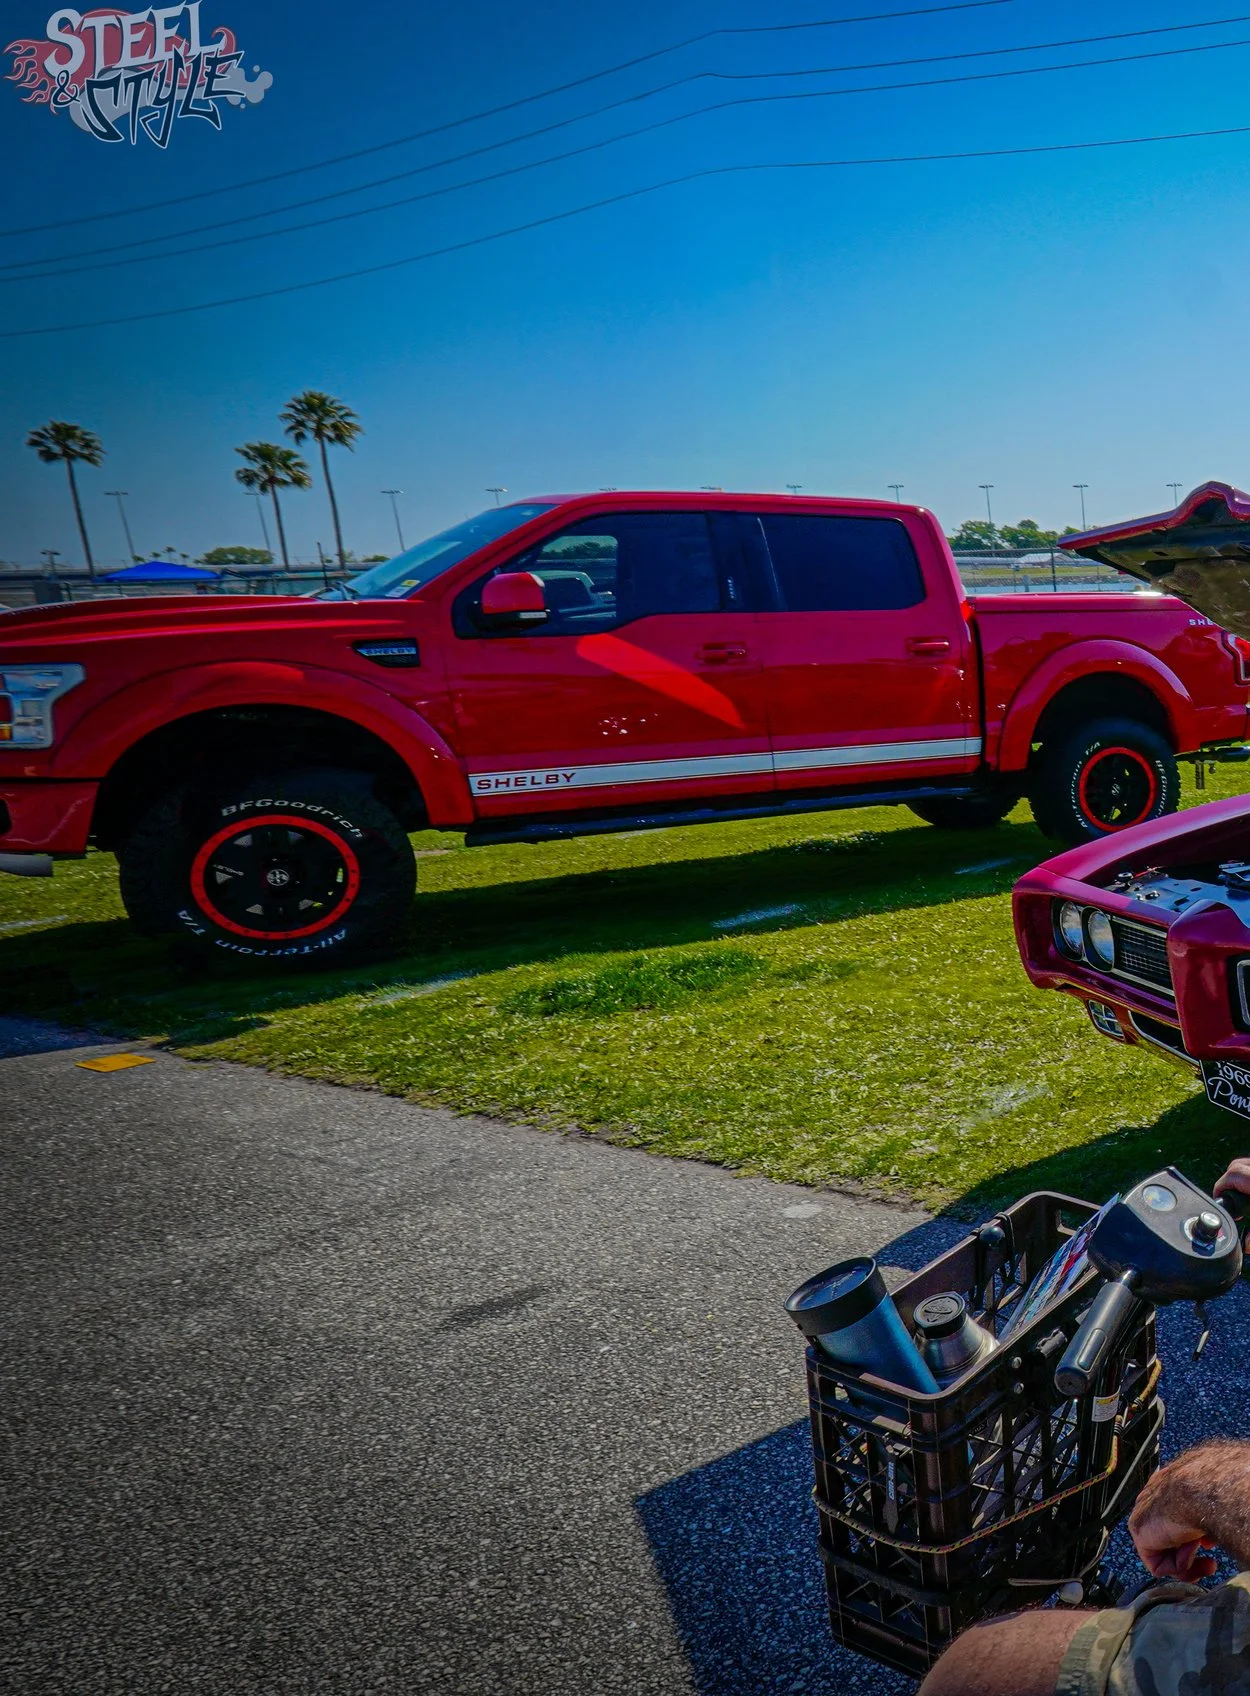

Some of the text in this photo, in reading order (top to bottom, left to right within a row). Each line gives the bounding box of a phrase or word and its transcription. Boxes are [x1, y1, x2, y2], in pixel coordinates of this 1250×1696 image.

[366, 647, 413, 655] SHELBY
[477, 772, 576, 790] SHELBY
[221, 798, 365, 839] BFGoodrich
